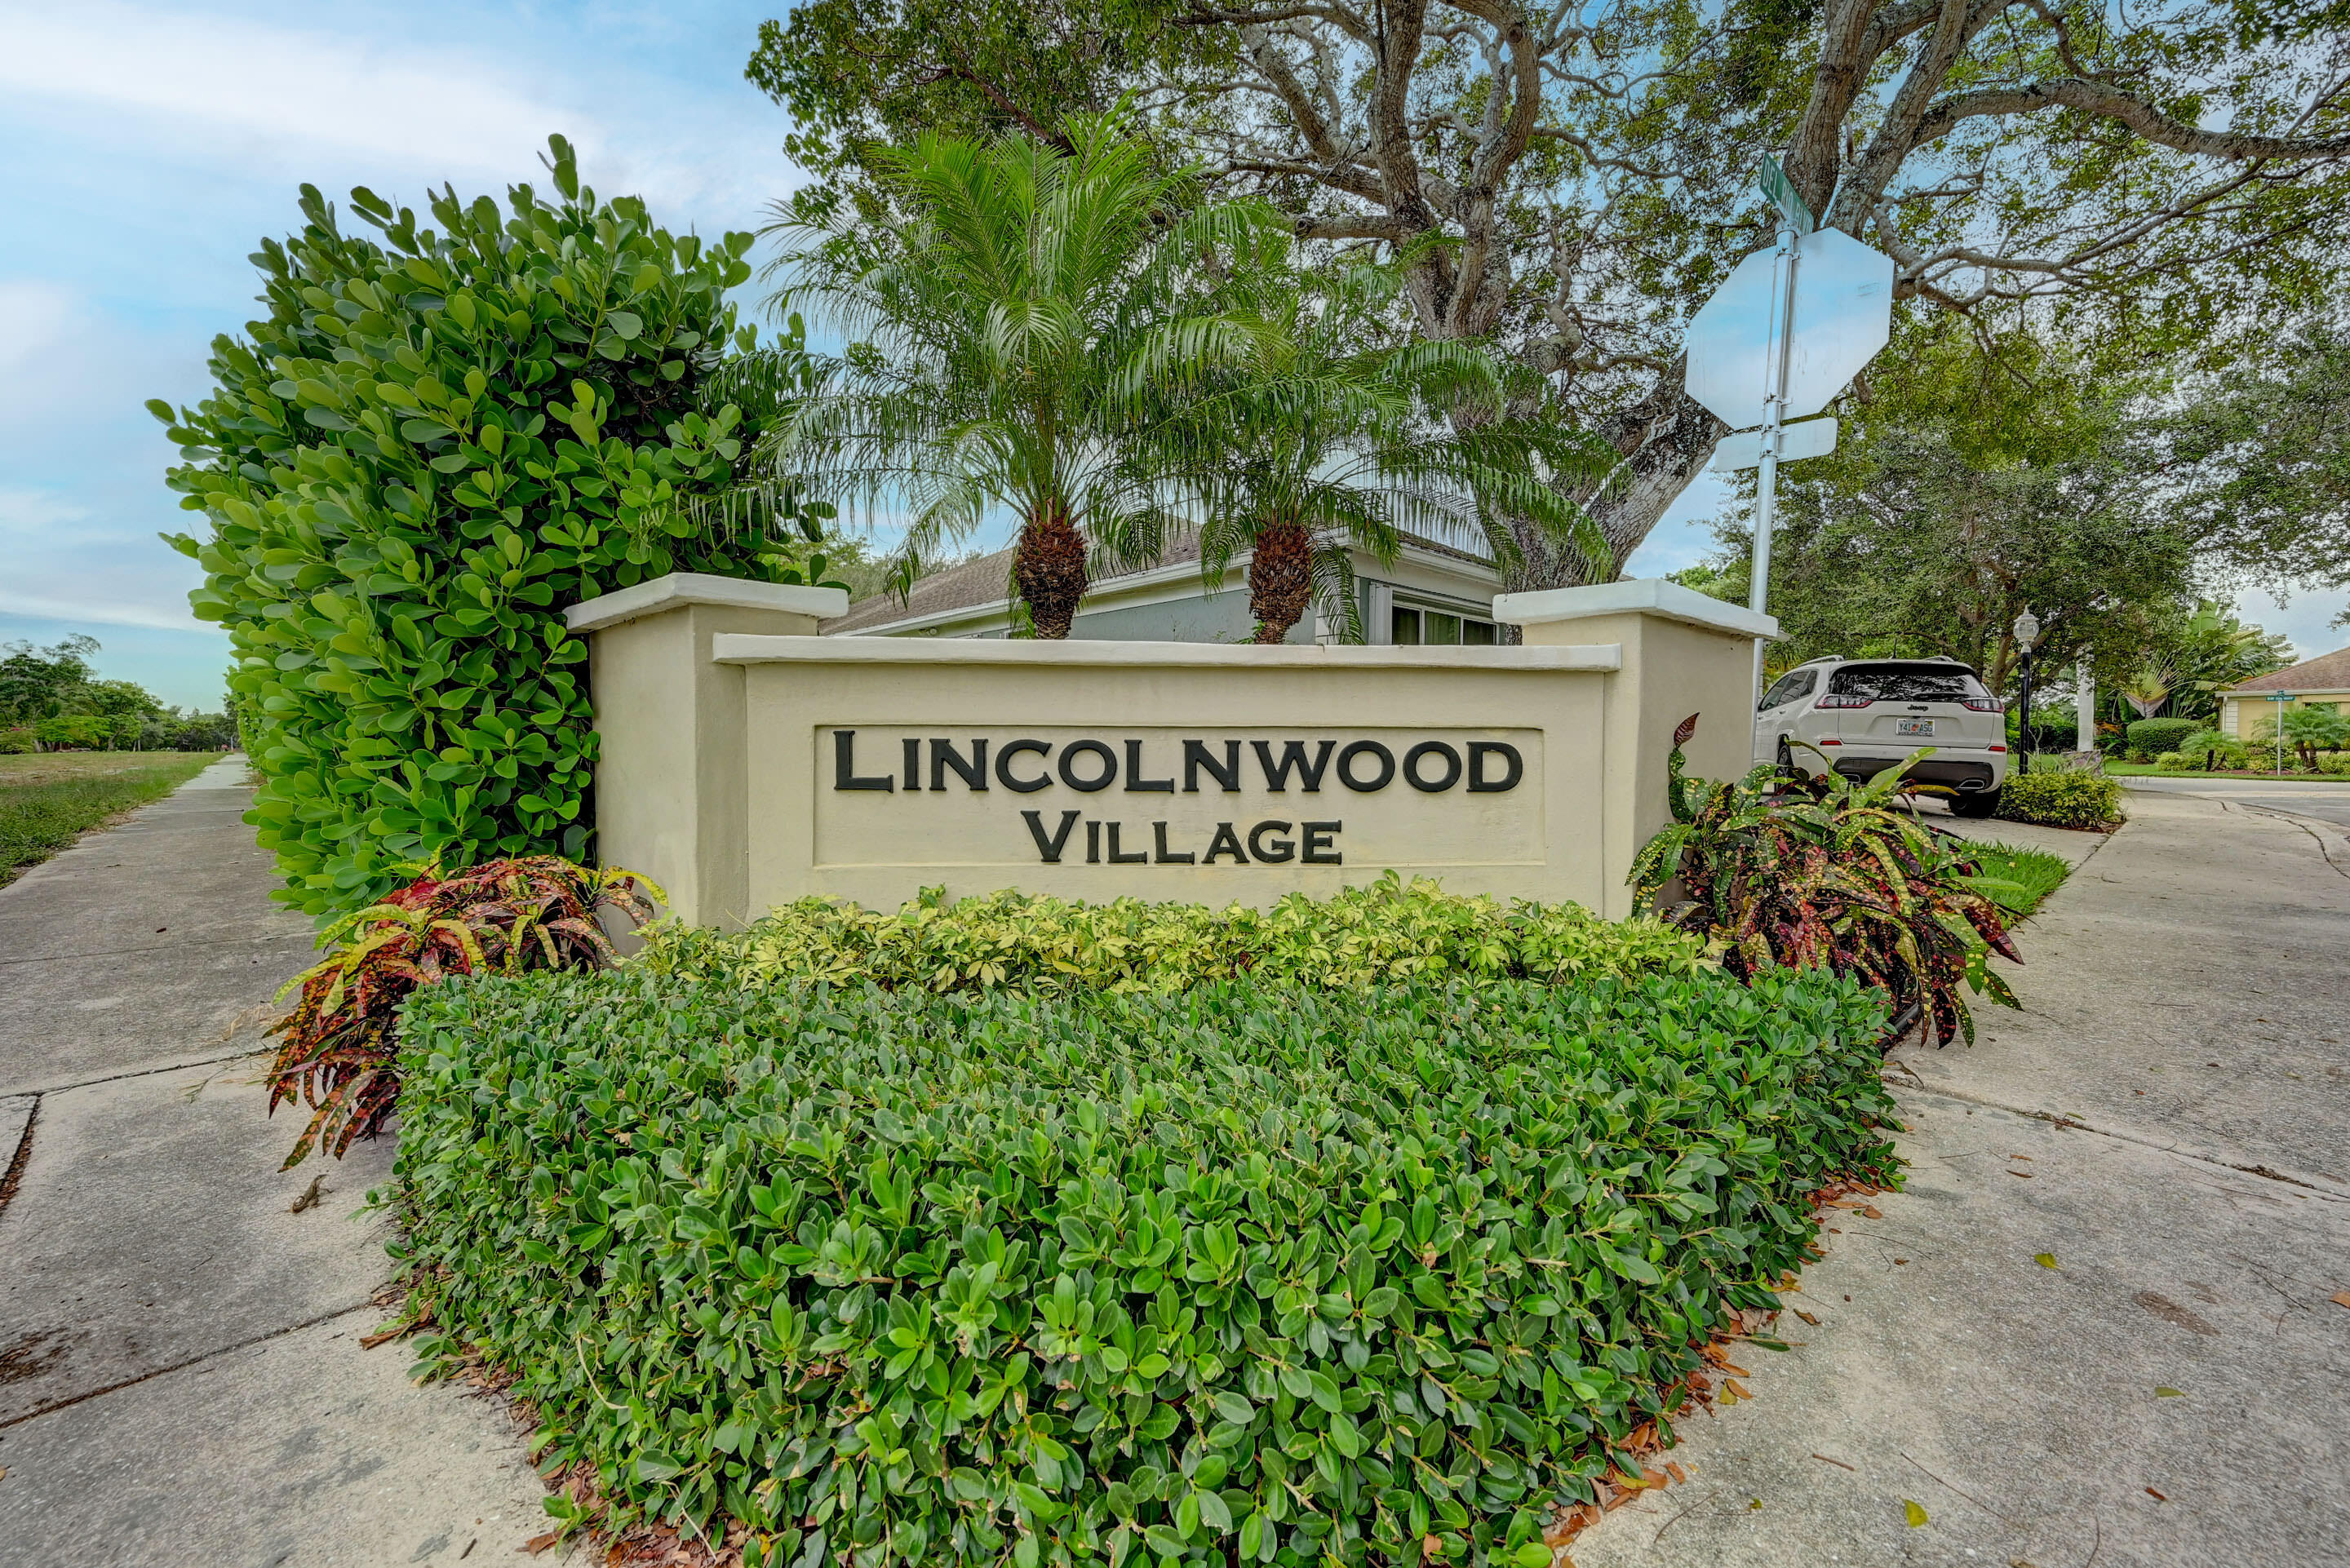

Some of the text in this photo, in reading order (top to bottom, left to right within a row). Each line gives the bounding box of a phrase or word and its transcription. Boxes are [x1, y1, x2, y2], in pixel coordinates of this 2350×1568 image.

[1762, 157, 1778, 202] DEL
[1780, 180, 1794, 214] RIO
[832, 730, 1523, 794] LINCOLNWOOD
[1020, 810, 1342, 866] VILLAGE
